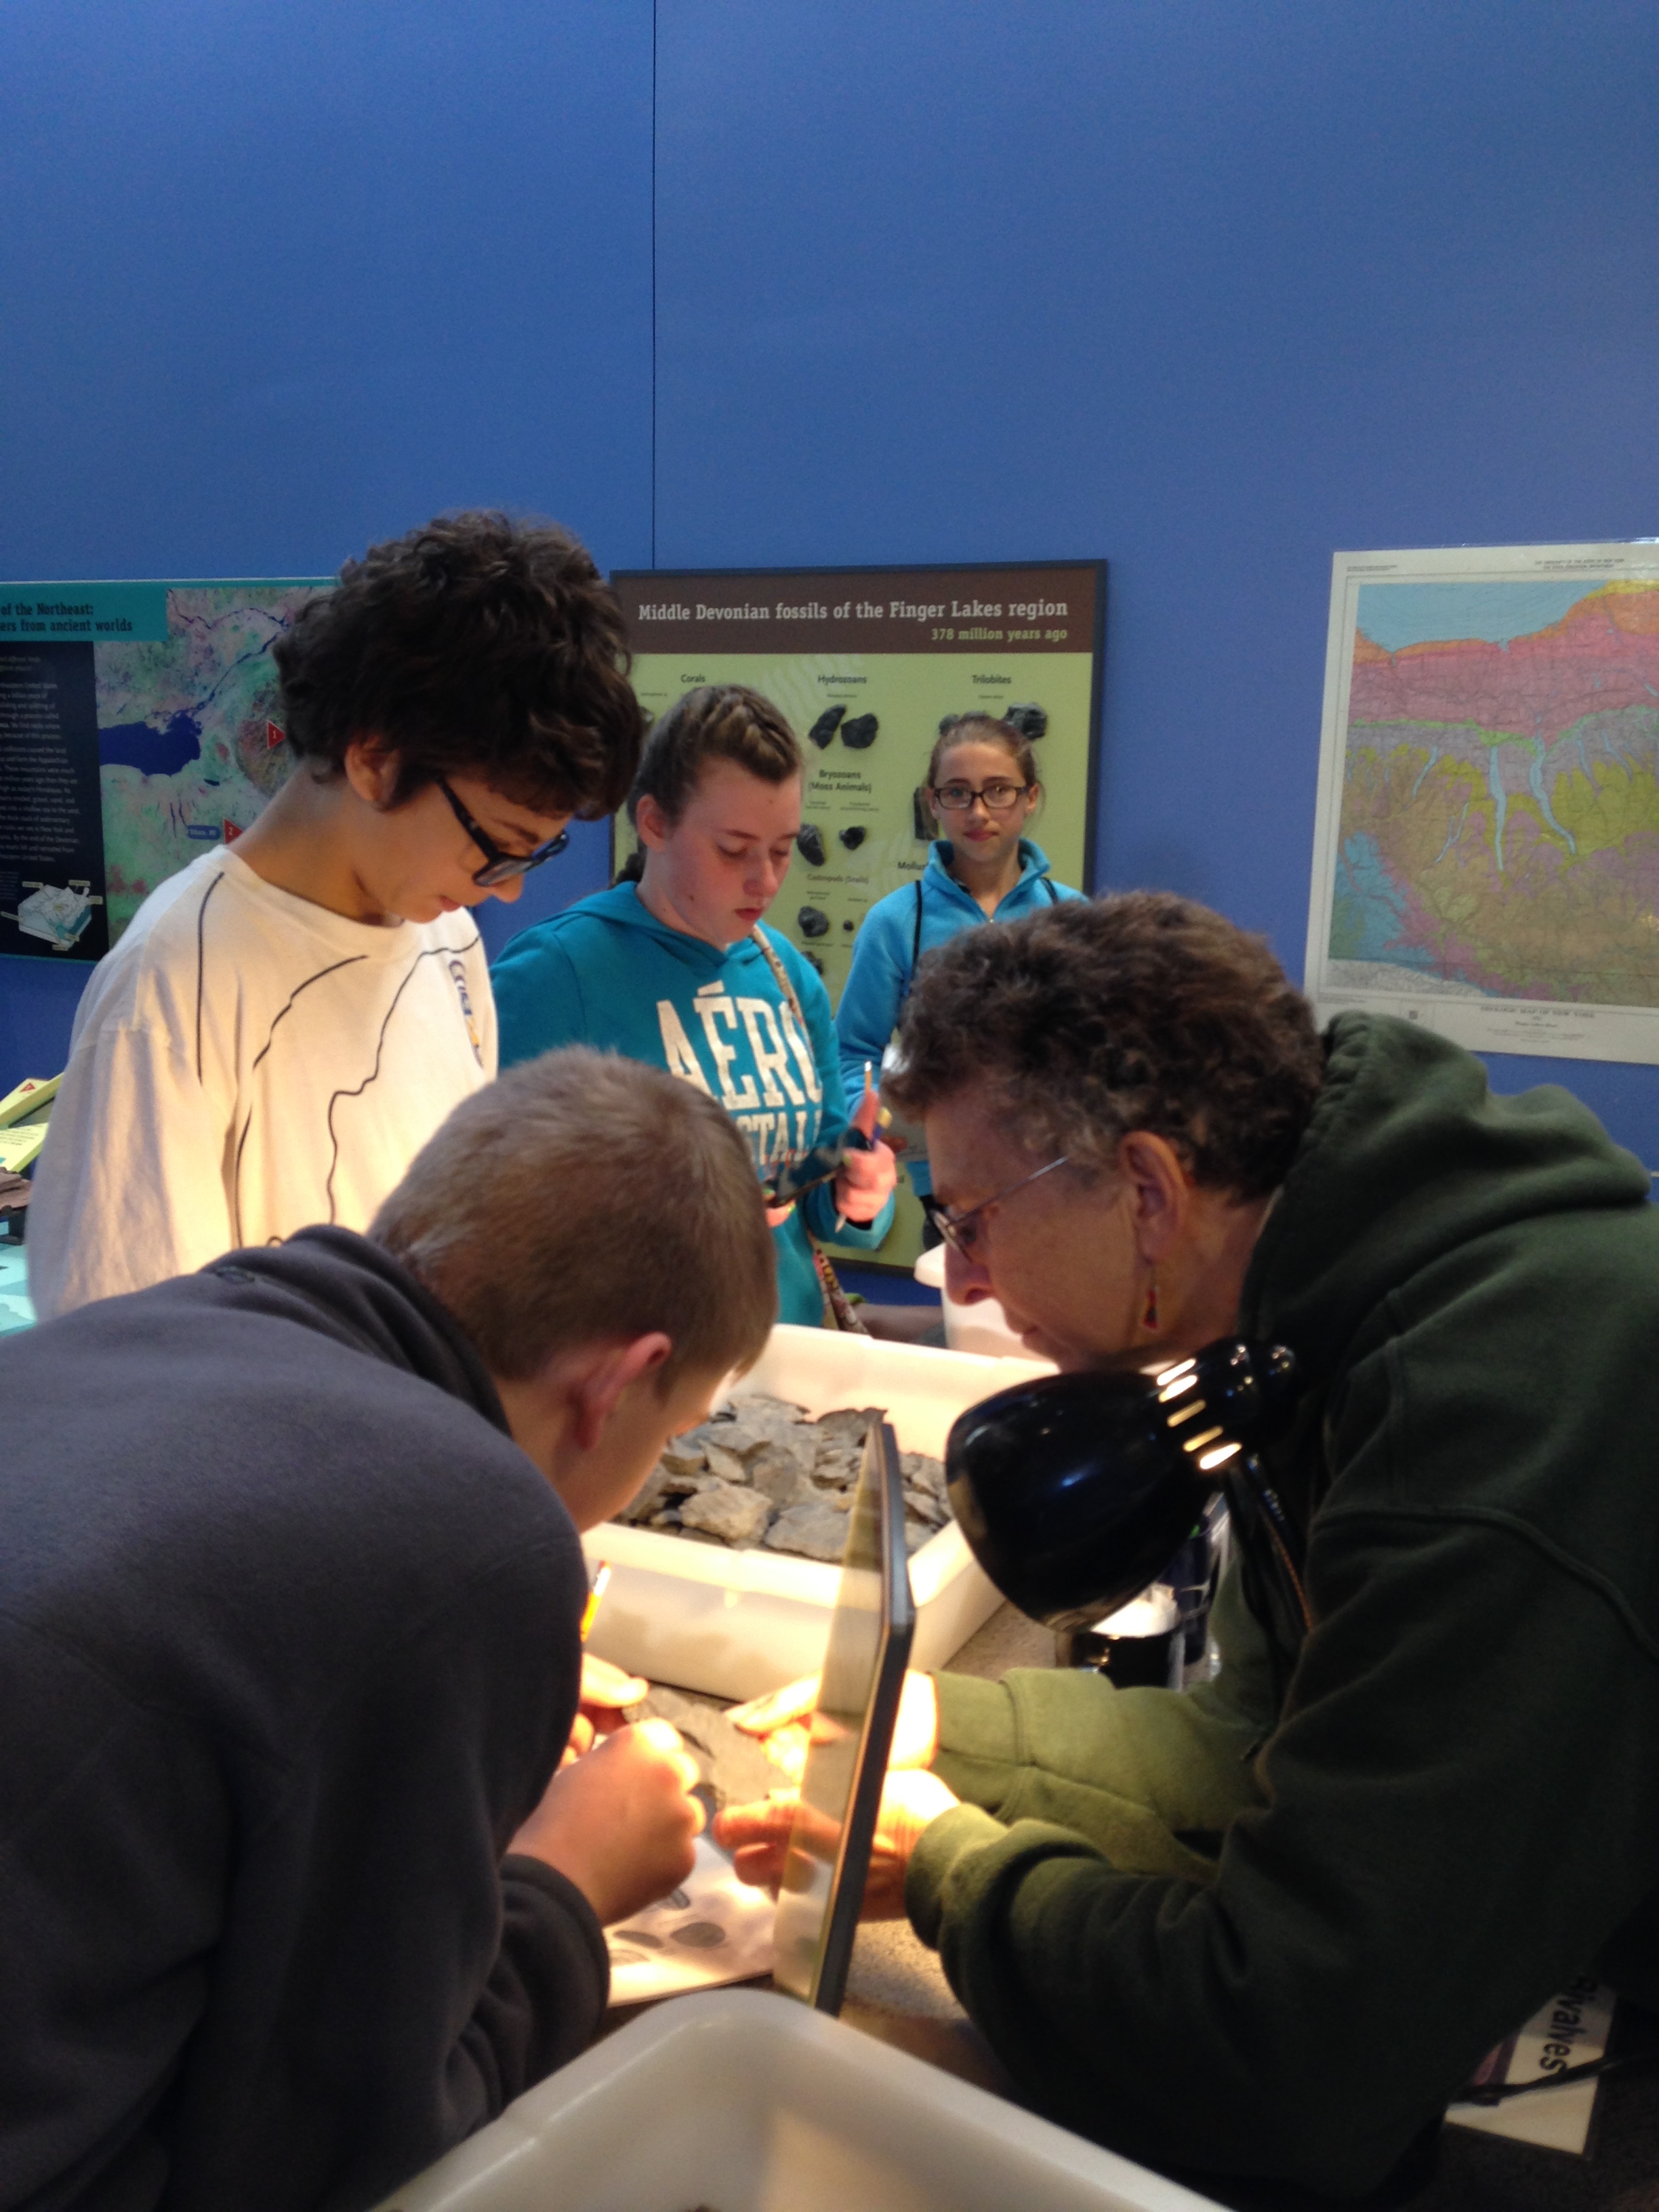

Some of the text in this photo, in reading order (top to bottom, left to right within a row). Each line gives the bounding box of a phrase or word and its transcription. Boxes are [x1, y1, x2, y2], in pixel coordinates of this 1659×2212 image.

[1, 602, 94, 615] of the Northeast:
[638, 598, 1069, 622] Middle Devonian fossils of the Finger Lakes region
[20, 618, 46, 632] from
[50, 619, 91, 632] ancient
[96, 617, 133, 632] worlds
[931, 627, 1068, 642] 378 million years ago
[680, 673, 705, 683] Corals
[817, 674, 867, 686] Hydrozoans
[971, 674, 1012, 684] Trilobites
[819, 769, 861, 780] Bryozoans
[808, 781, 872, 794] (Moss Animals)
